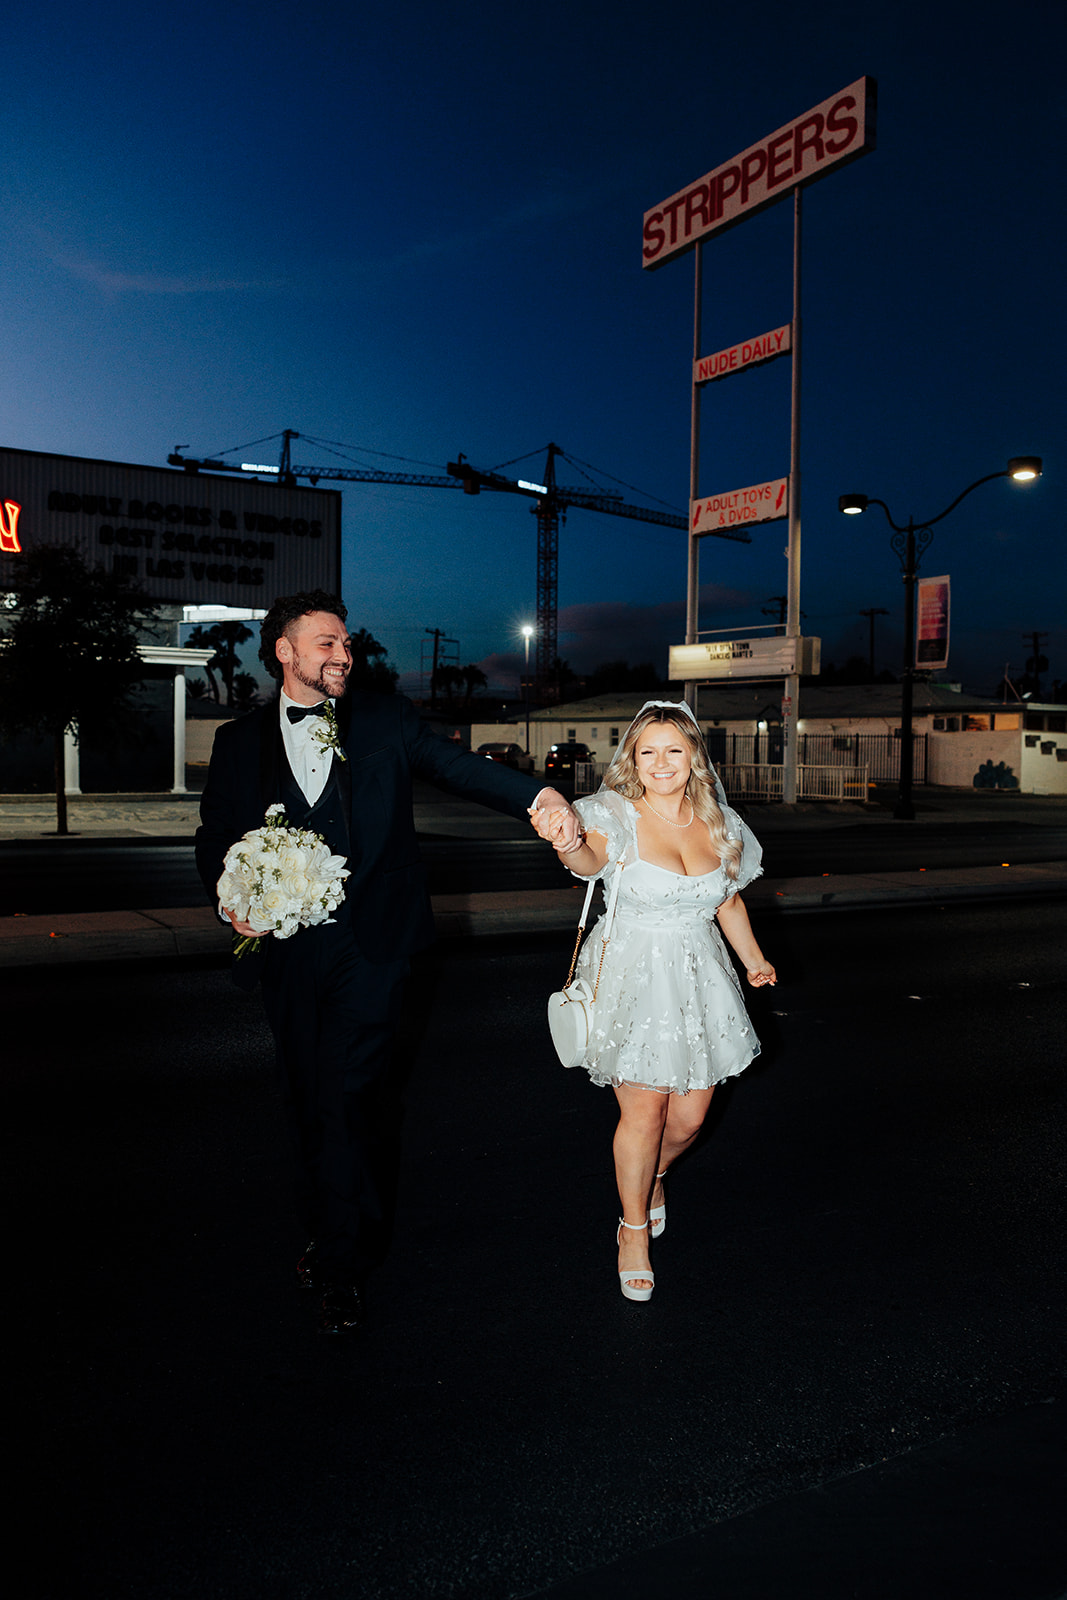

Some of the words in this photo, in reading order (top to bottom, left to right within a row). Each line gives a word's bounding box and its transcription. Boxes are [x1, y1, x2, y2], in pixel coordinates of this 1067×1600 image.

[643, 96, 858, 258] STRIPPERS
[699, 349, 738, 380] NUDE
[742, 330, 784, 363] DAILY
[48, 490, 122, 517] ADULT
[128, 500, 211, 526] BOOKS
[219, 510, 237, 530] &
[244, 511, 322, 538] VIDEOS
[705, 494, 739, 514] ADULT
[742, 486, 772, 504] TOYS
[719, 512, 725, 525] &
[729, 506, 757, 523] DVDs
[100, 525, 155, 548] BEST
[162, 531, 275, 560] SELECTION
[113, 555, 138, 577] IN
[146, 557, 185, 579] LAS
[190, 562, 264, 586] VEGAS
